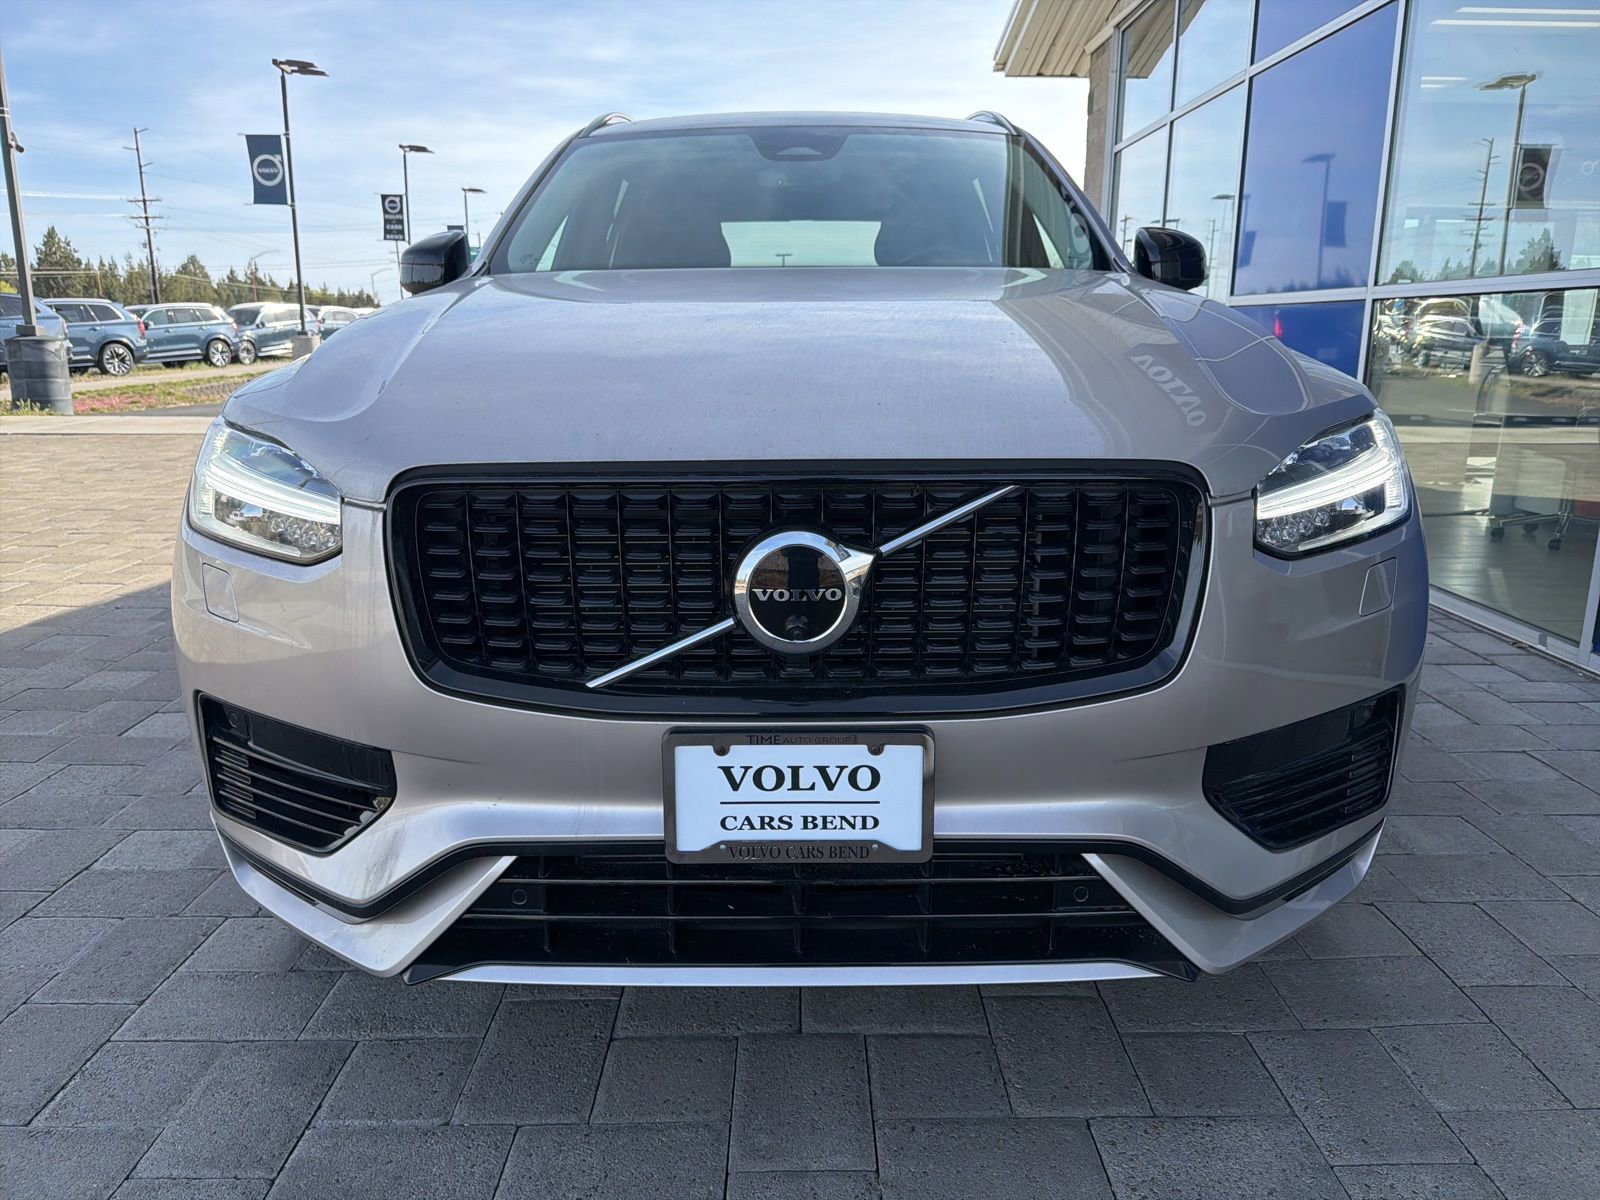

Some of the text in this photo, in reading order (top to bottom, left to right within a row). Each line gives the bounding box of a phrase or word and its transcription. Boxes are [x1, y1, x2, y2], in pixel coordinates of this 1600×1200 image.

[752, 588, 843, 602] VOLVO
[746, 735, 780, 745] TIME
[783, 736, 811, 744] AUTO
[718, 765, 881, 792] VOLVO
[720, 815, 880, 831] CARS BEND
[729, 845, 870, 859] VOLVO CARS BEND
